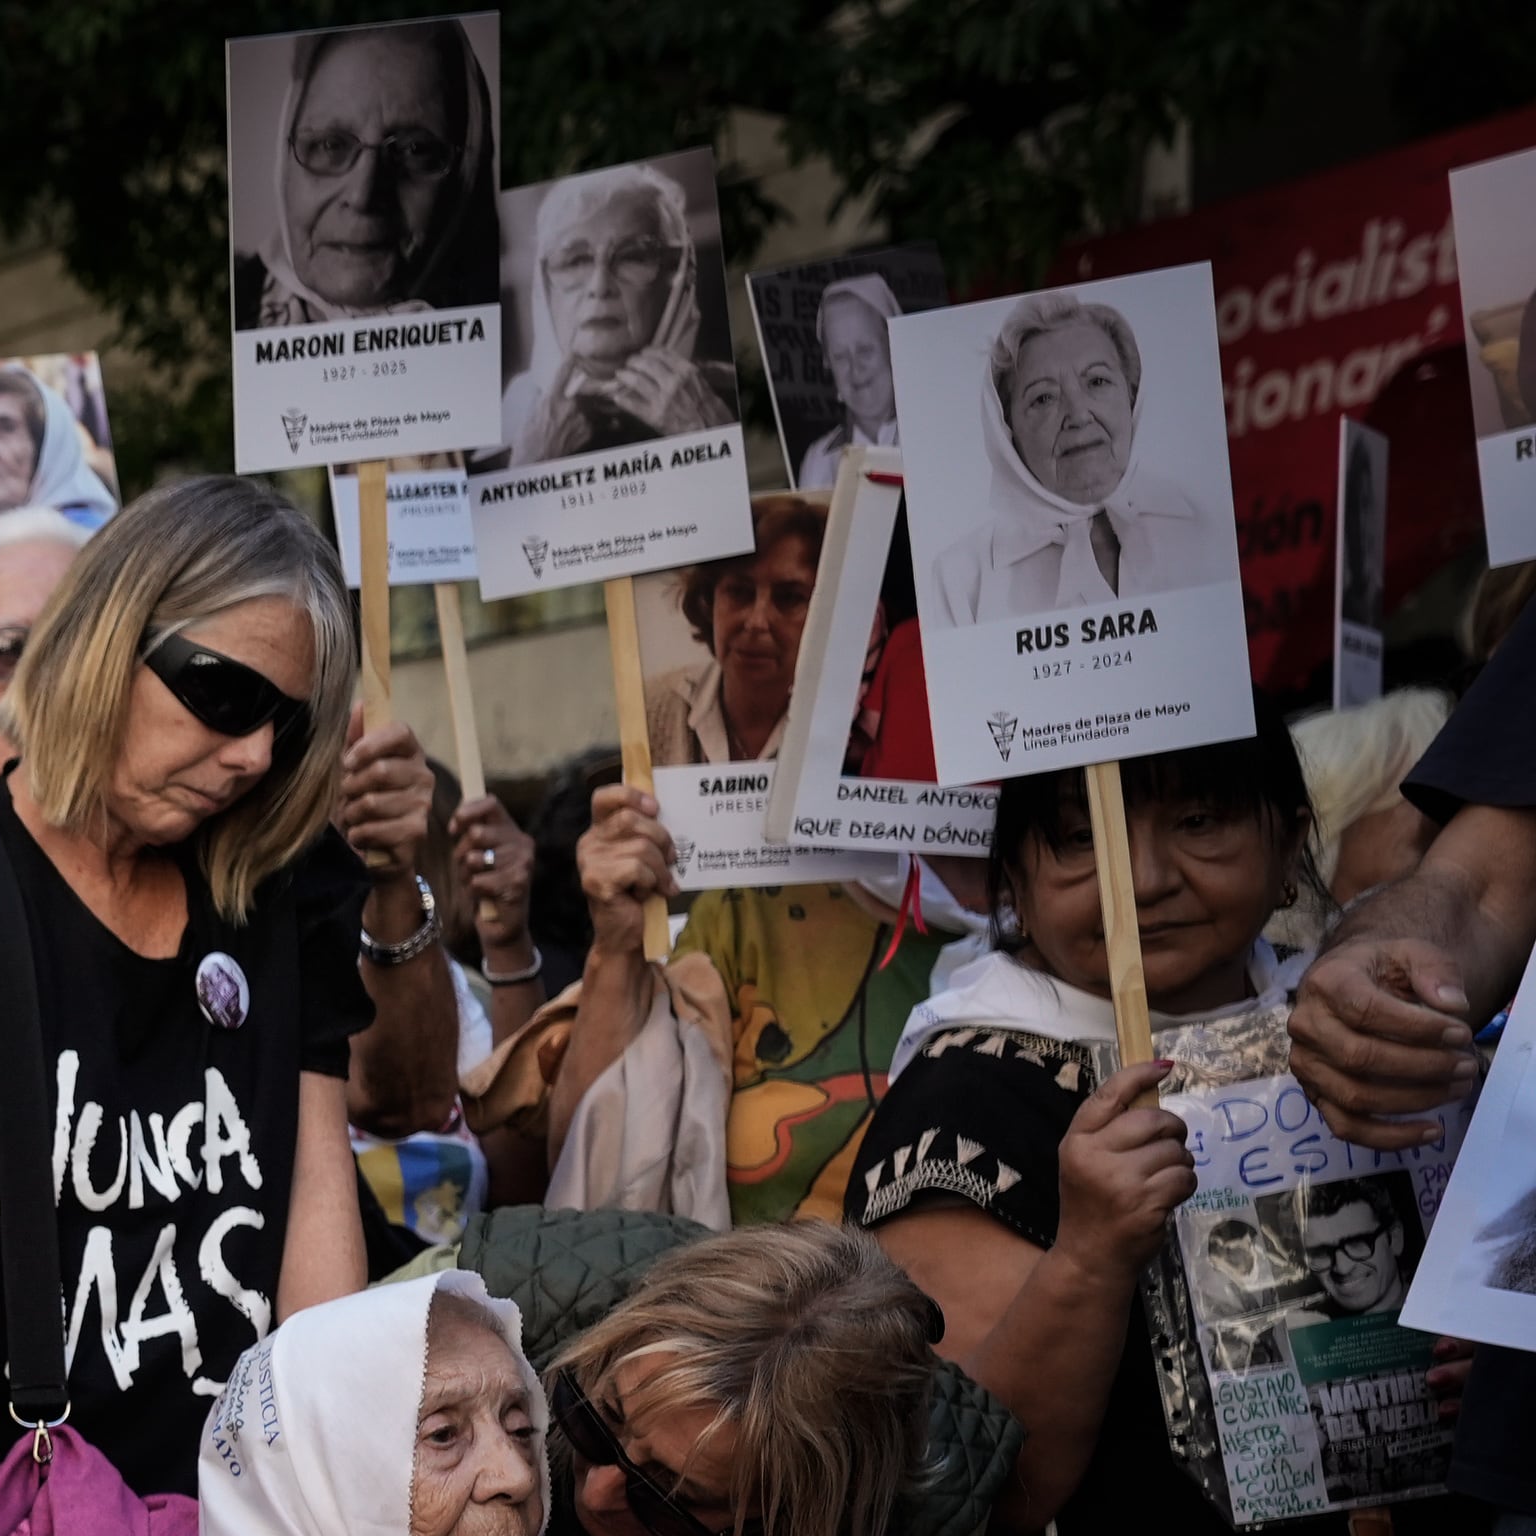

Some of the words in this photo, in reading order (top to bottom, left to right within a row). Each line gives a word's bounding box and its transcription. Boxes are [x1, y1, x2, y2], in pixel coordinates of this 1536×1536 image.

[256, 332, 344, 366] MARONI
[354, 317, 485, 353] ENRIQUETA
[309, 421, 351, 434] Madres
[354, 418, 368, 430] de
[370, 415, 401, 428] Plaza
[403, 413, 417, 425] de
[420, 410, 451, 423] Mayo
[480, 467, 596, 506] ANTOKOLETZ
[603, 451, 662, 480] MARÍA
[671, 439, 731, 467] ADELA
[552, 544, 592, 558] Madres
[596, 540, 611, 552] de
[613, 535, 646, 550] Plaza
[649, 531, 663, 543] de
[666, 524, 698, 539] Mayo
[1016, 623, 1070, 655] RUS
[1081, 608, 1158, 643] SARA
[1032, 660, 1072, 681] 1927
[1092, 650, 1133, 670] 2024
[1022, 721, 1071, 739] Madres
[1075, 717, 1091, 730] de
[1095, 713, 1131, 728] Plaza
[1135, 708, 1151, 720] de
[1155, 702, 1191, 719] Mayo
[1061, 725, 1130, 745] Fundadora
[699, 774, 768, 796] SABINO
[837, 783, 908, 806] DANIEL
[849, 821, 916, 842] DIGAN
[1219, 1372, 1295, 1404] GUSTAVO
[1328, 1412, 1365, 1442] DEL
